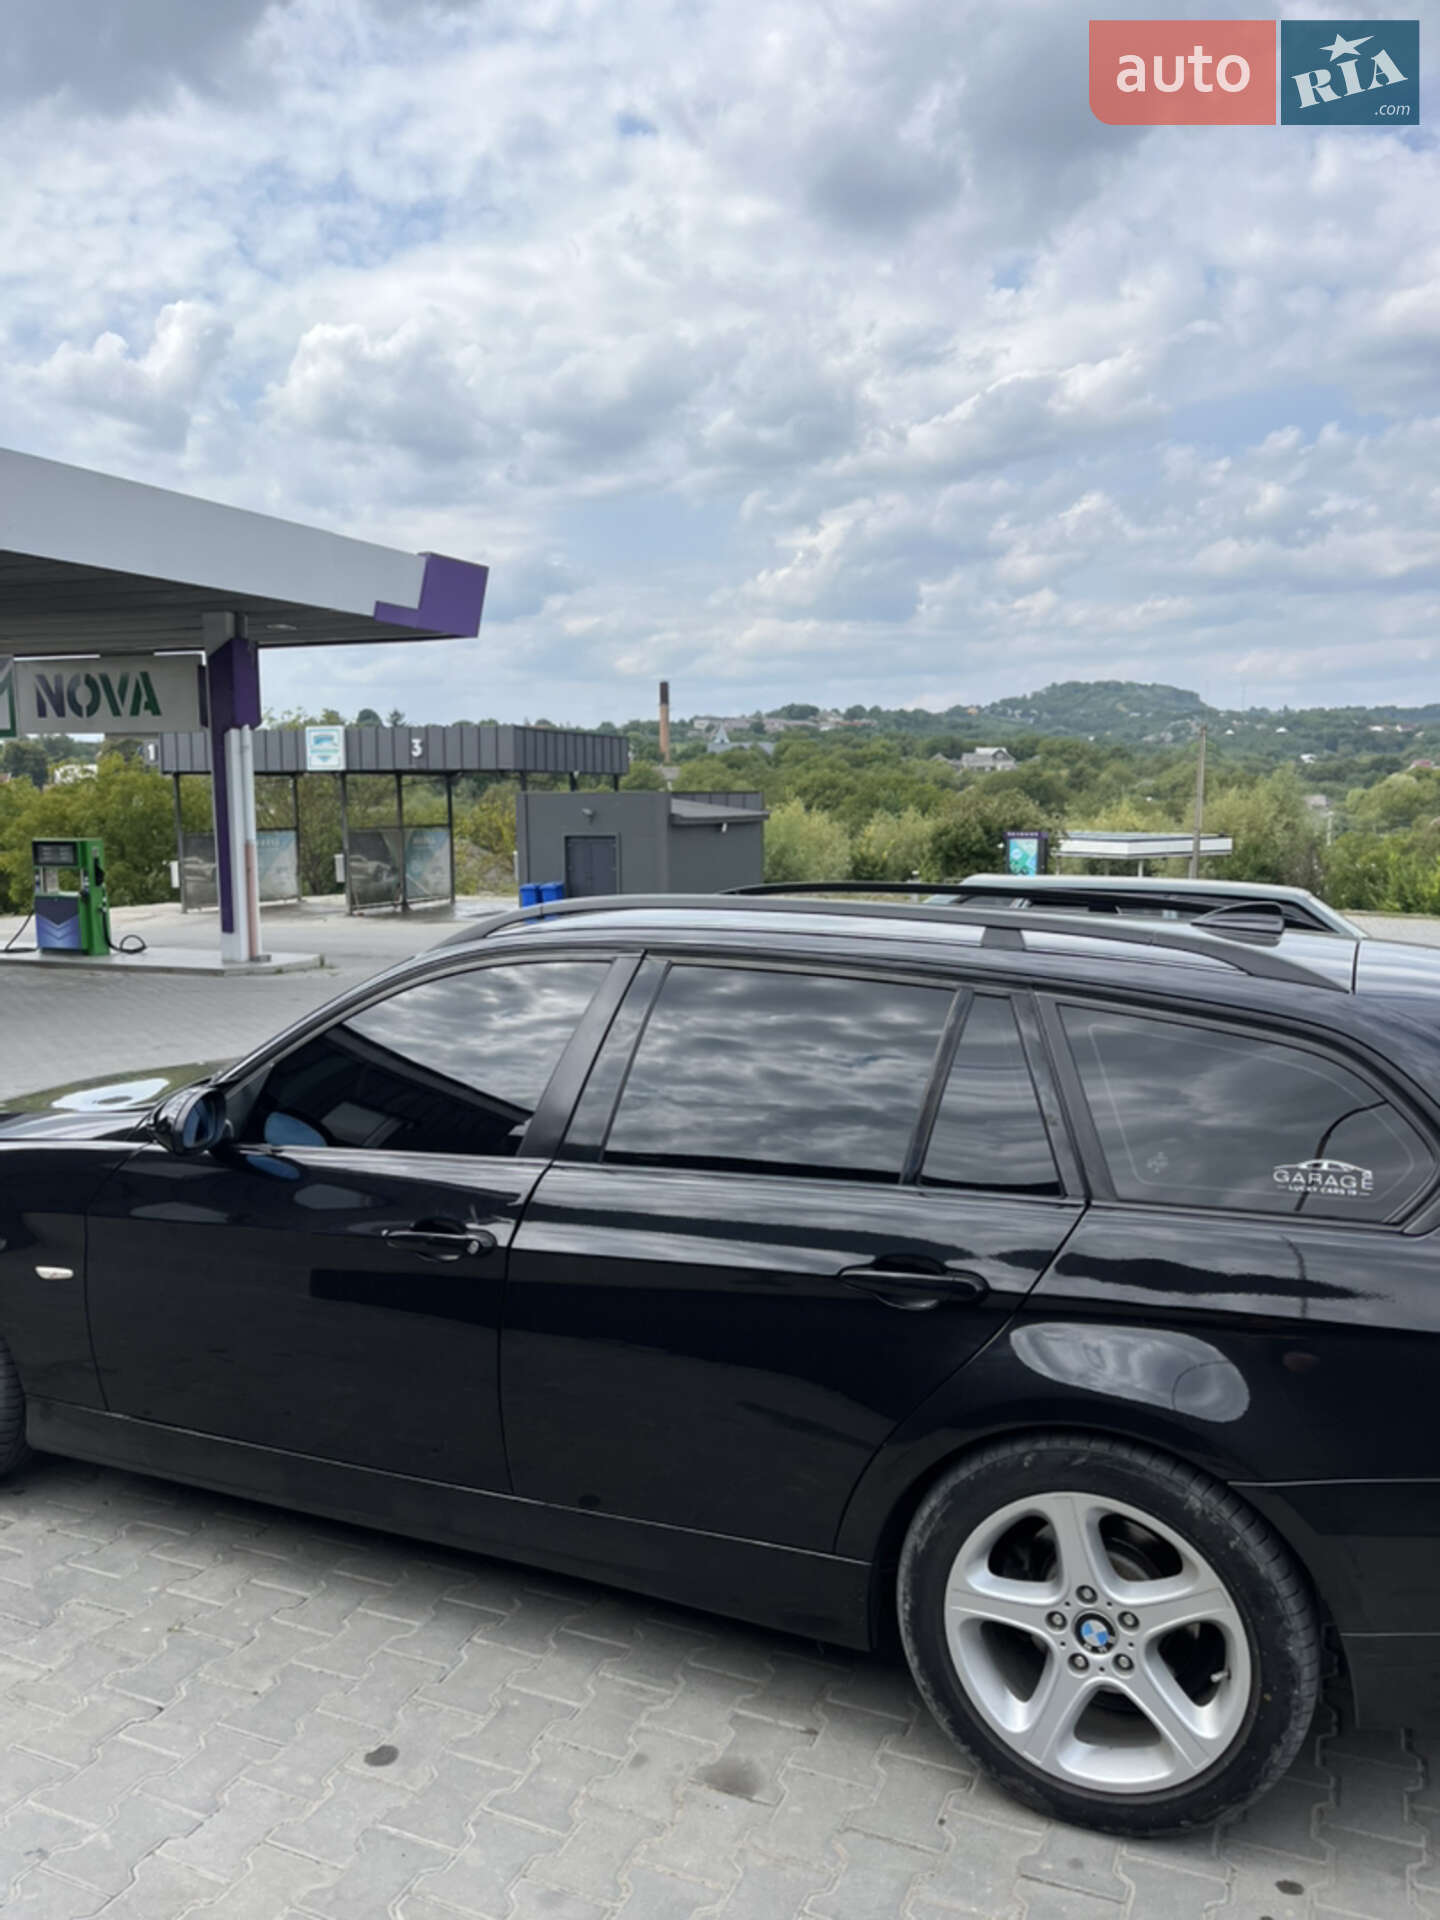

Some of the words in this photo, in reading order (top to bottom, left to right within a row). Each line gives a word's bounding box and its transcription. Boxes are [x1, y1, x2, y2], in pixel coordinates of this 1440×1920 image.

[35, 671, 163, 718] NOVA
[148, 743, 155, 760] 1
[411, 738, 422, 757] 3
[1273, 1169, 1373, 1190] GARAGE
